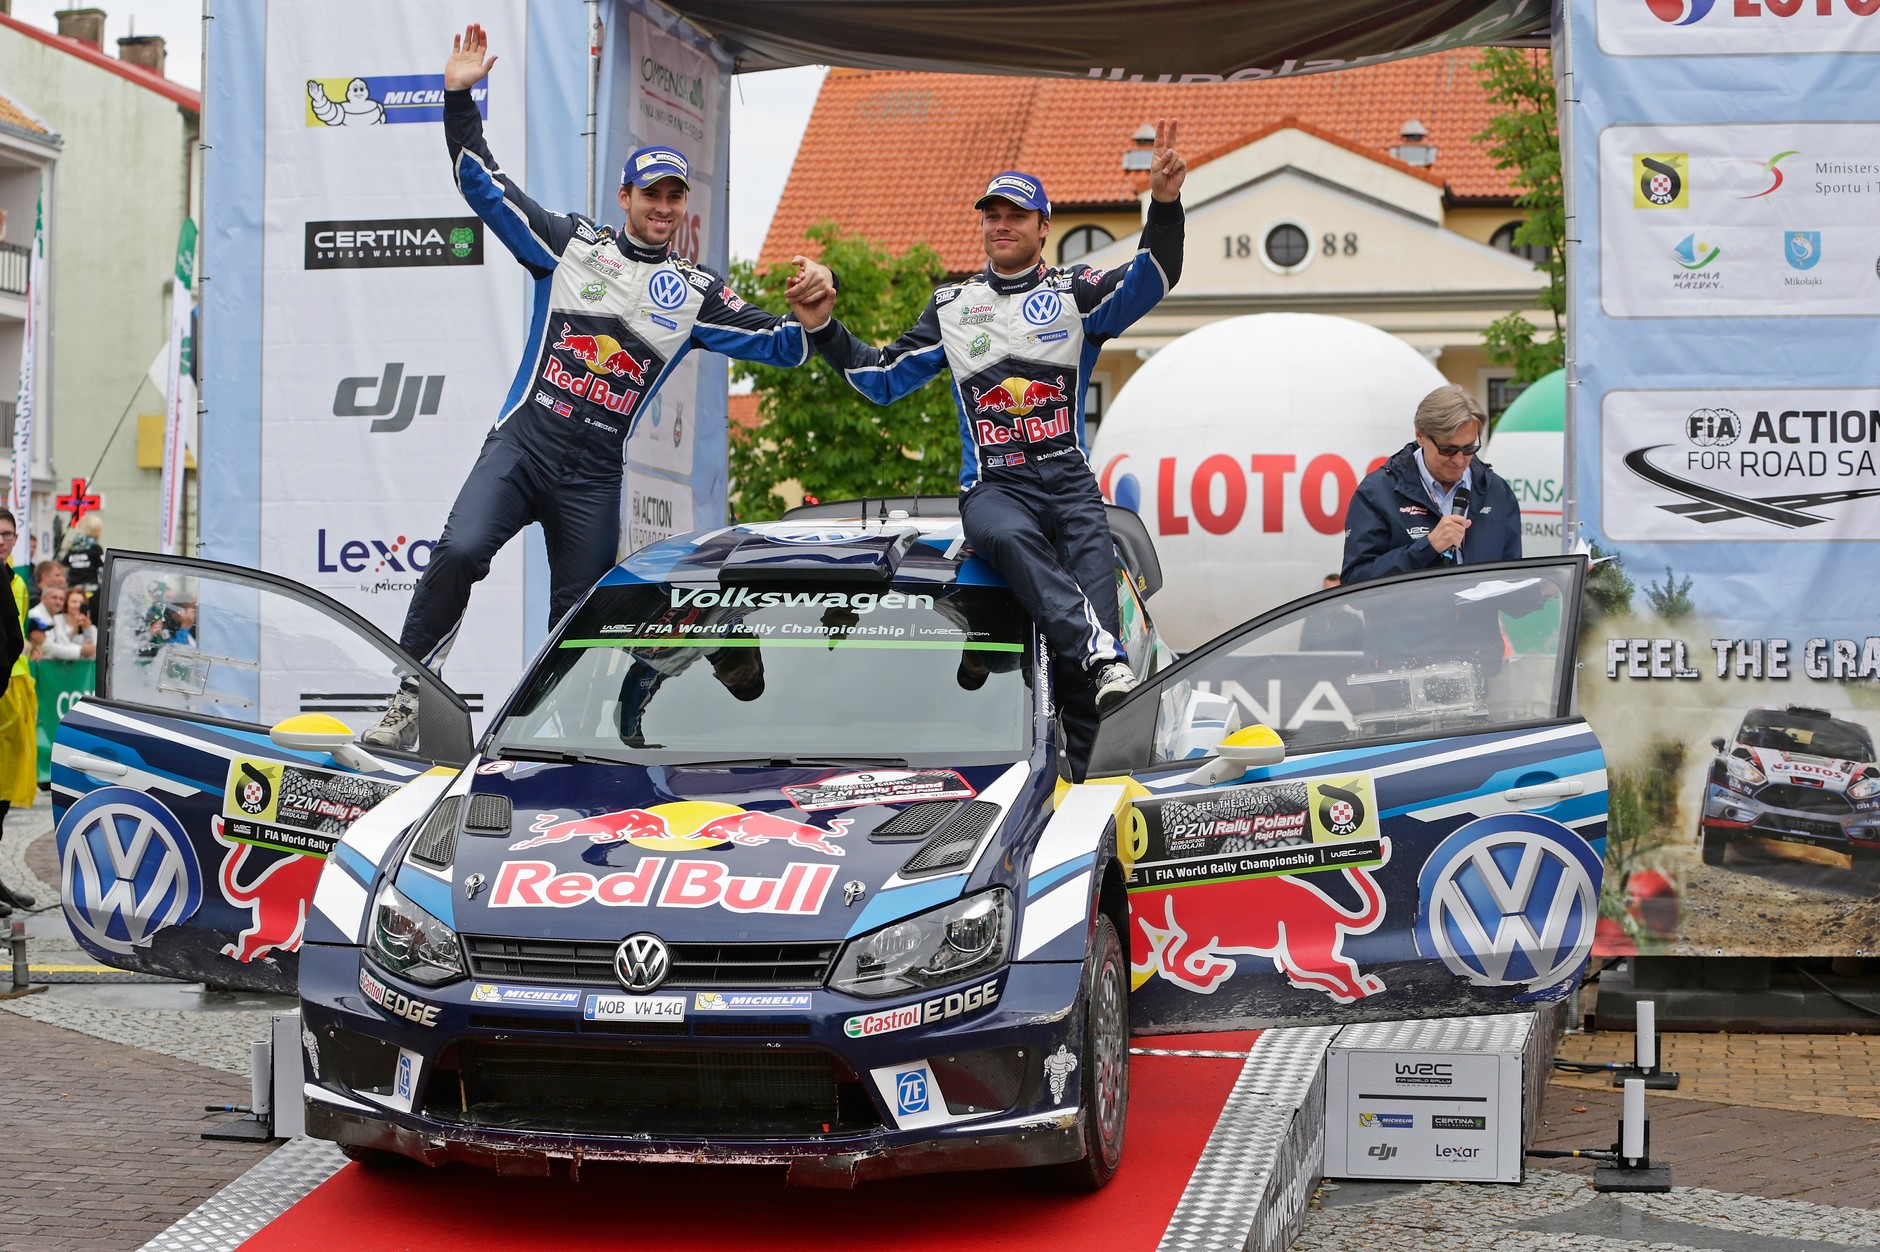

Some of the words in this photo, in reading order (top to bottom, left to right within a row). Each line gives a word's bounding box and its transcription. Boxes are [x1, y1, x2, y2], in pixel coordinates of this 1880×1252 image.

[383, 88, 487, 104] MICHN
[1815, 182, 1861, 196] Sportu
[1650, 193, 1673, 205] PZM
[314, 229, 445, 248] CERTINA
[317, 250, 364, 259] SWISS
[373, 248, 443, 258] WATCHES
[582, 256, 622, 279] EDGE
[597, 254, 622, 270] Castrol
[689, 274, 710, 290] OMP
[1673, 272, 1720, 280] WARMIA
[1784, 276, 1823, 286] Mikołajki
[1001, 281, 1029, 291] Volkswagen
[1674, 281, 1720, 289] MAZURY
[969, 305, 993, 315] Castrol
[1041, 332, 1068, 341] MICHELIN
[542, 354, 594, 397] Red
[586, 377, 640, 416] Bull
[535, 393, 554, 406] OMP
[975, 417, 1027, 446] Red
[1024, 406, 1071, 443] Bull
[1687, 451, 1731, 470] FOR
[1741, 451, 1827, 477] ROAD
[1837, 450, 1877, 477] SA
[1157, 453, 1389, 536] LOTO
[641, 497, 672, 528] ACTION
[318, 528, 439, 573] Lexa
[360, 584, 369, 593] by
[670, 587, 935, 614] Volkswagen
[644, 624, 673, 634] FIA
[678, 623, 725, 634] World
[733, 623, 777, 637] Rally
[781, 623, 905, 638] Championship
[1606, 638, 1698, 678] FEEL
[1711, 638, 1788, 678] THE
[858, 774, 875, 783] 9
[1794, 764, 1842, 779] LOTOS
[328, 781, 343, 792] THE
[811, 789, 854, 799] PZM
[854, 785, 890, 796] Rally
[892, 780, 944, 791] Poland
[241, 801, 262, 814] PZM
[283, 793, 321, 811] PZM
[318, 800, 349, 819] Rally
[1219, 798, 1238, 809] THE
[1238, 794, 1274, 807] GRAVEL
[1171, 821, 1215, 840] PZM
[1213, 816, 1250, 836] Rally
[1253, 810, 1306, 831] Poland
[1331, 821, 1357, 835] PZM
[264, 829, 280, 842] FIA
[281, 831, 306, 846] World
[308, 838, 330, 853] Rally
[1254, 829, 1274, 841] Rajd
[1275, 827, 1303, 839] Polski
[1155, 870, 1174, 881] FIA
[1175, 864, 1208, 878] World
[1210, 861, 1237, 875] Rally
[1240, 853, 1315, 871] Championship
[488, 857, 668, 909] Red
[655, 858, 840, 915] Bull
[362, 973, 383, 1003] Castrol
[381, 988, 442, 1028] EDGE
[503, 989, 578, 1002] MICHELIN
[729, 995, 808, 1007] MICHELIN
[597, 1000, 625, 1014] WOB
[863, 1006, 919, 1034] Castrol
[923, 978, 1000, 1024] EDGE
[900, 1076, 928, 1108] ZF
[1434, 1117, 1474, 1125] CERTINA
[1435, 1143, 1480, 1158] Lexar
